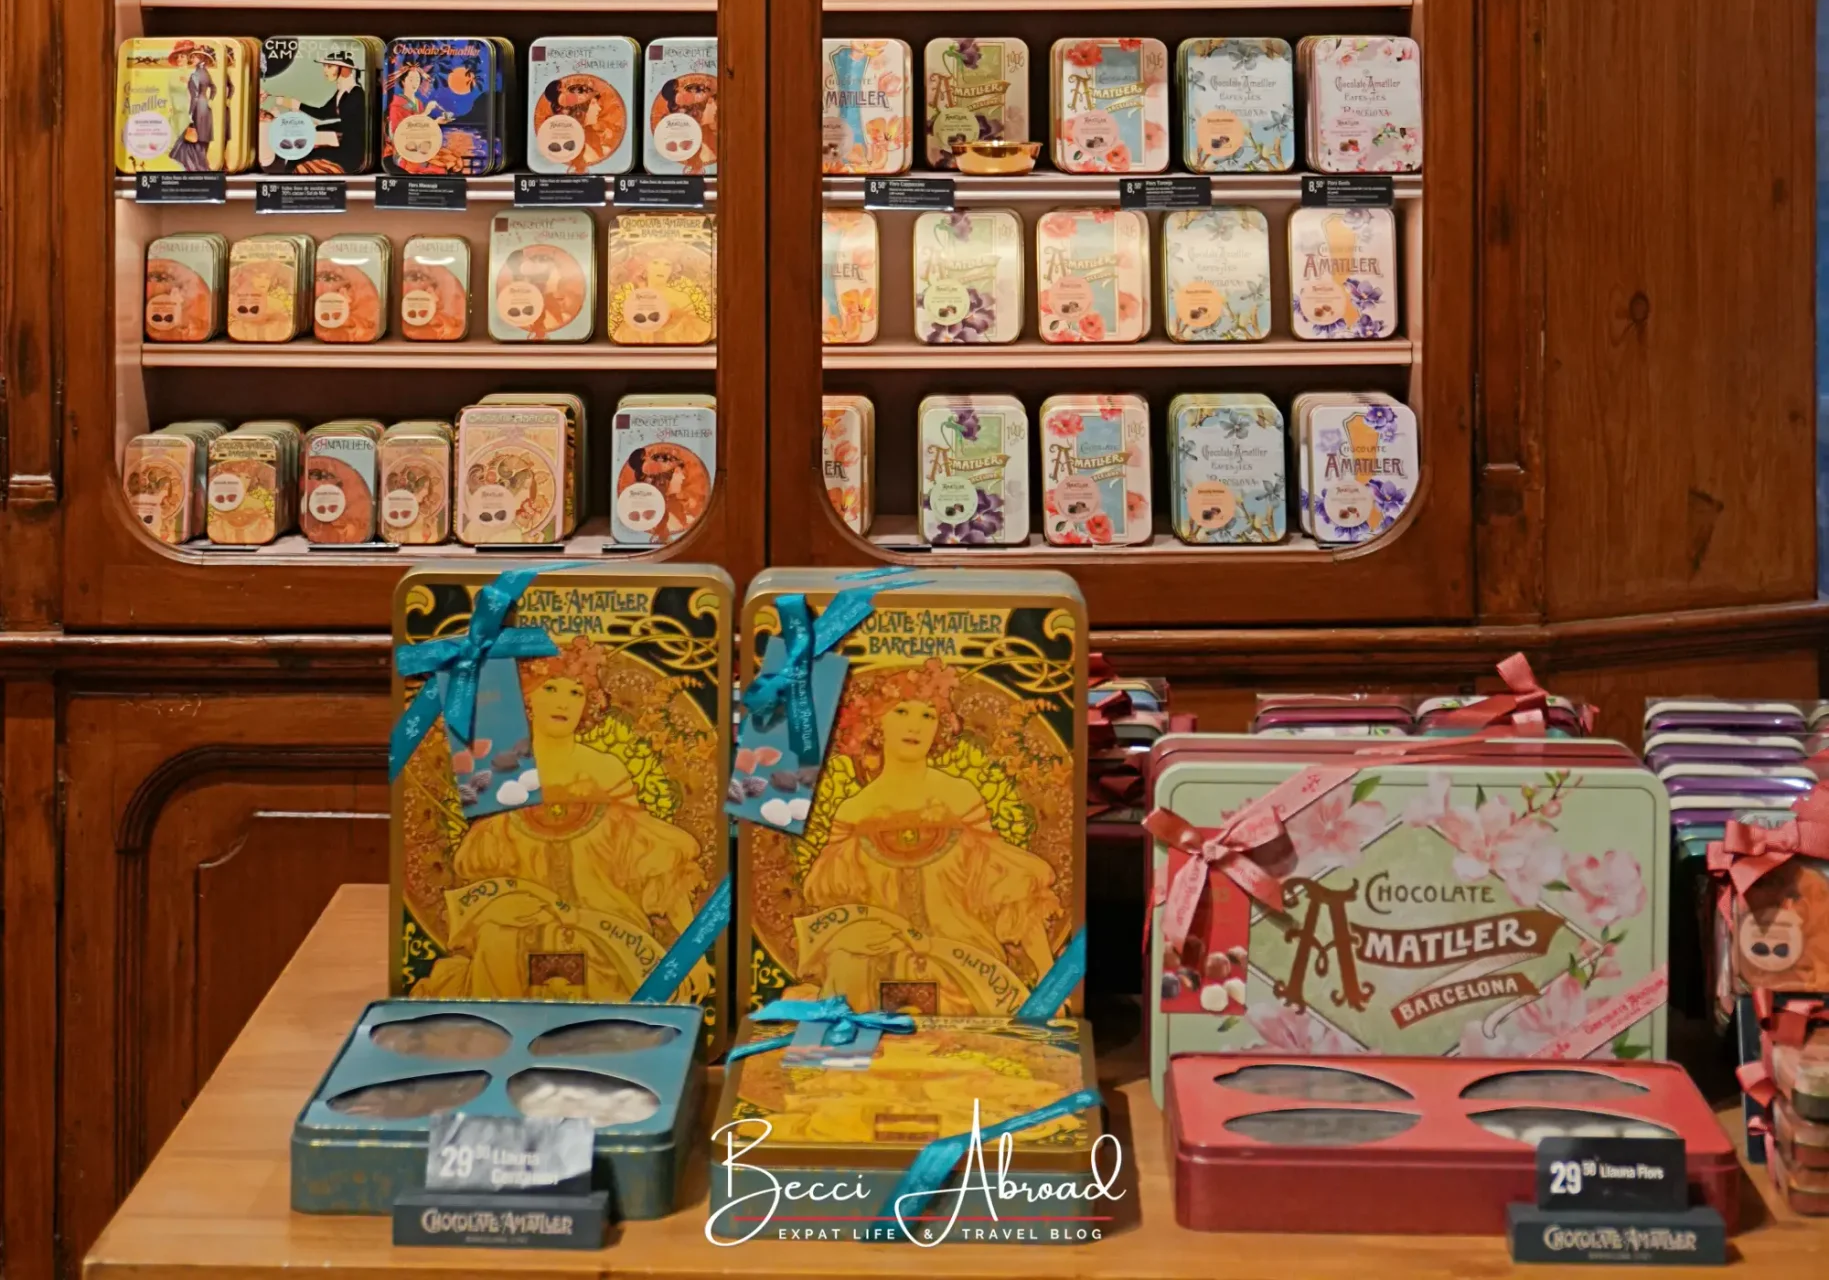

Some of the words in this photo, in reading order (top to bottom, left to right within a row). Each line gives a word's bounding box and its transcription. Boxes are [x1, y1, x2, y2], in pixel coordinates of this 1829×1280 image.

[265, 40, 360, 51] CHOCOLATE
[393, 43, 439, 57] Chocolate
[440, 45, 481, 57] Amatller
[824, 90, 892, 112] MATLLER
[1303, 254, 1384, 280] AMATLLER
[927, 444, 1003, 482] AMATLLER
[1049, 444, 1124, 483] AMATLLER
[1325, 453, 1408, 480] AMATLLER
[516, 589, 563, 613] OLATE
[566, 589, 649, 614] AMATLLER
[518, 615, 605, 636] BARCELONA
[861, 610, 915, 634] OLATE
[917, 609, 1002, 635] AMATLLER
[868, 636, 957, 658] BARCELONA
[458, 879, 499, 914] Casa
[1365, 871, 1496, 915] CHOCOLATE
[808, 907, 849, 943] Casa
[1398, 976, 1519, 1021] BARCELONA
[1637, 1162, 1665, 1180] Flors
[421, 1208, 499, 1234] CHOCOLATE
[501, 1211, 573, 1235] AMATLLER
[1543, 1225, 1622, 1251] CHOCOLATE
[1625, 1226, 1697, 1252] AMATLLER
